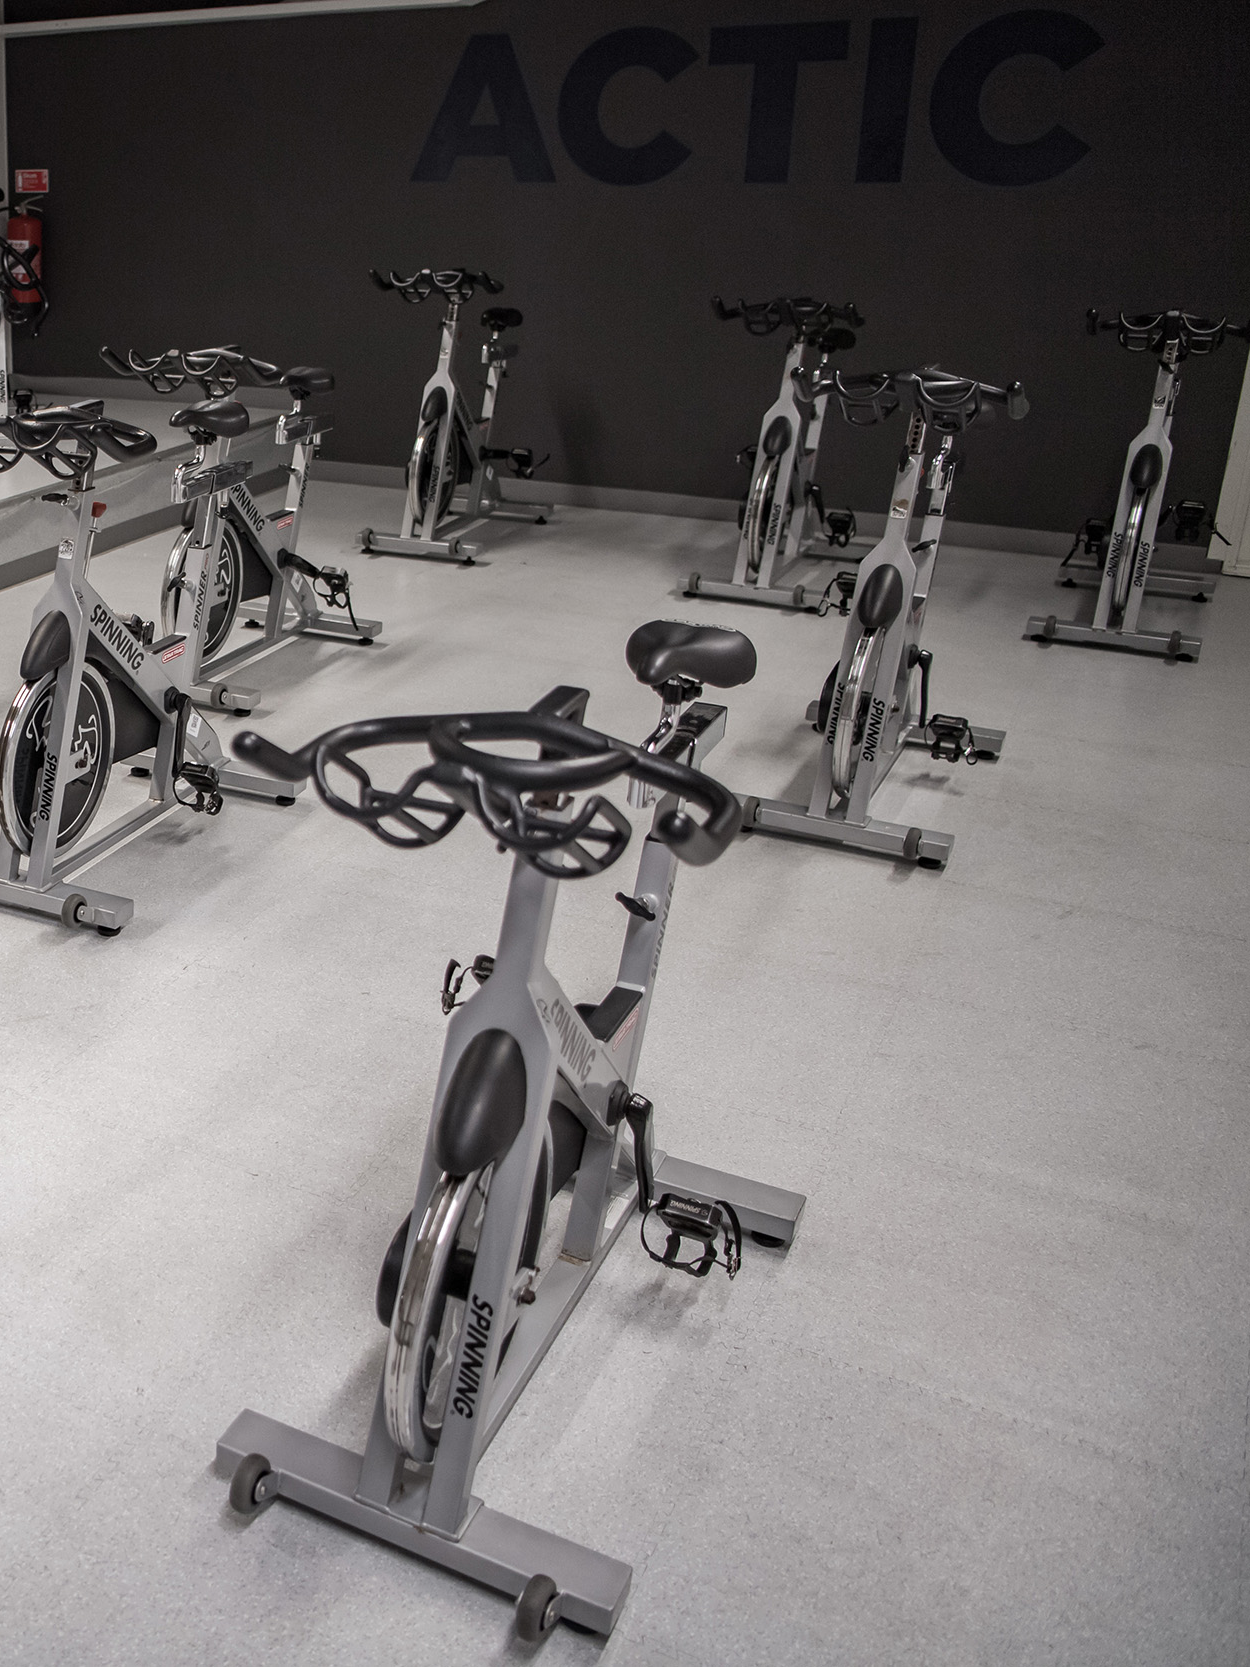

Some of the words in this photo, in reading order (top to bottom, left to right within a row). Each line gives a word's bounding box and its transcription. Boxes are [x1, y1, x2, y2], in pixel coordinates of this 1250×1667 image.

[410, 9, 1107, 187] ACTIC
[231, 484, 265, 532] PINNING
[1107, 531, 1123, 578] SPINNING
[1133, 541, 1150, 588] SPINNING
[193, 570, 208, 631] SPINNER
[90, 604, 144, 670] SPINNING
[862, 698, 886, 762] SPINNING
[39, 752, 58, 821] SPINNING
[551, 999, 596, 1082] SPINNING
[670, 1200, 701, 1214] SPINNING
[452, 1294, 493, 1419] SPINNING
